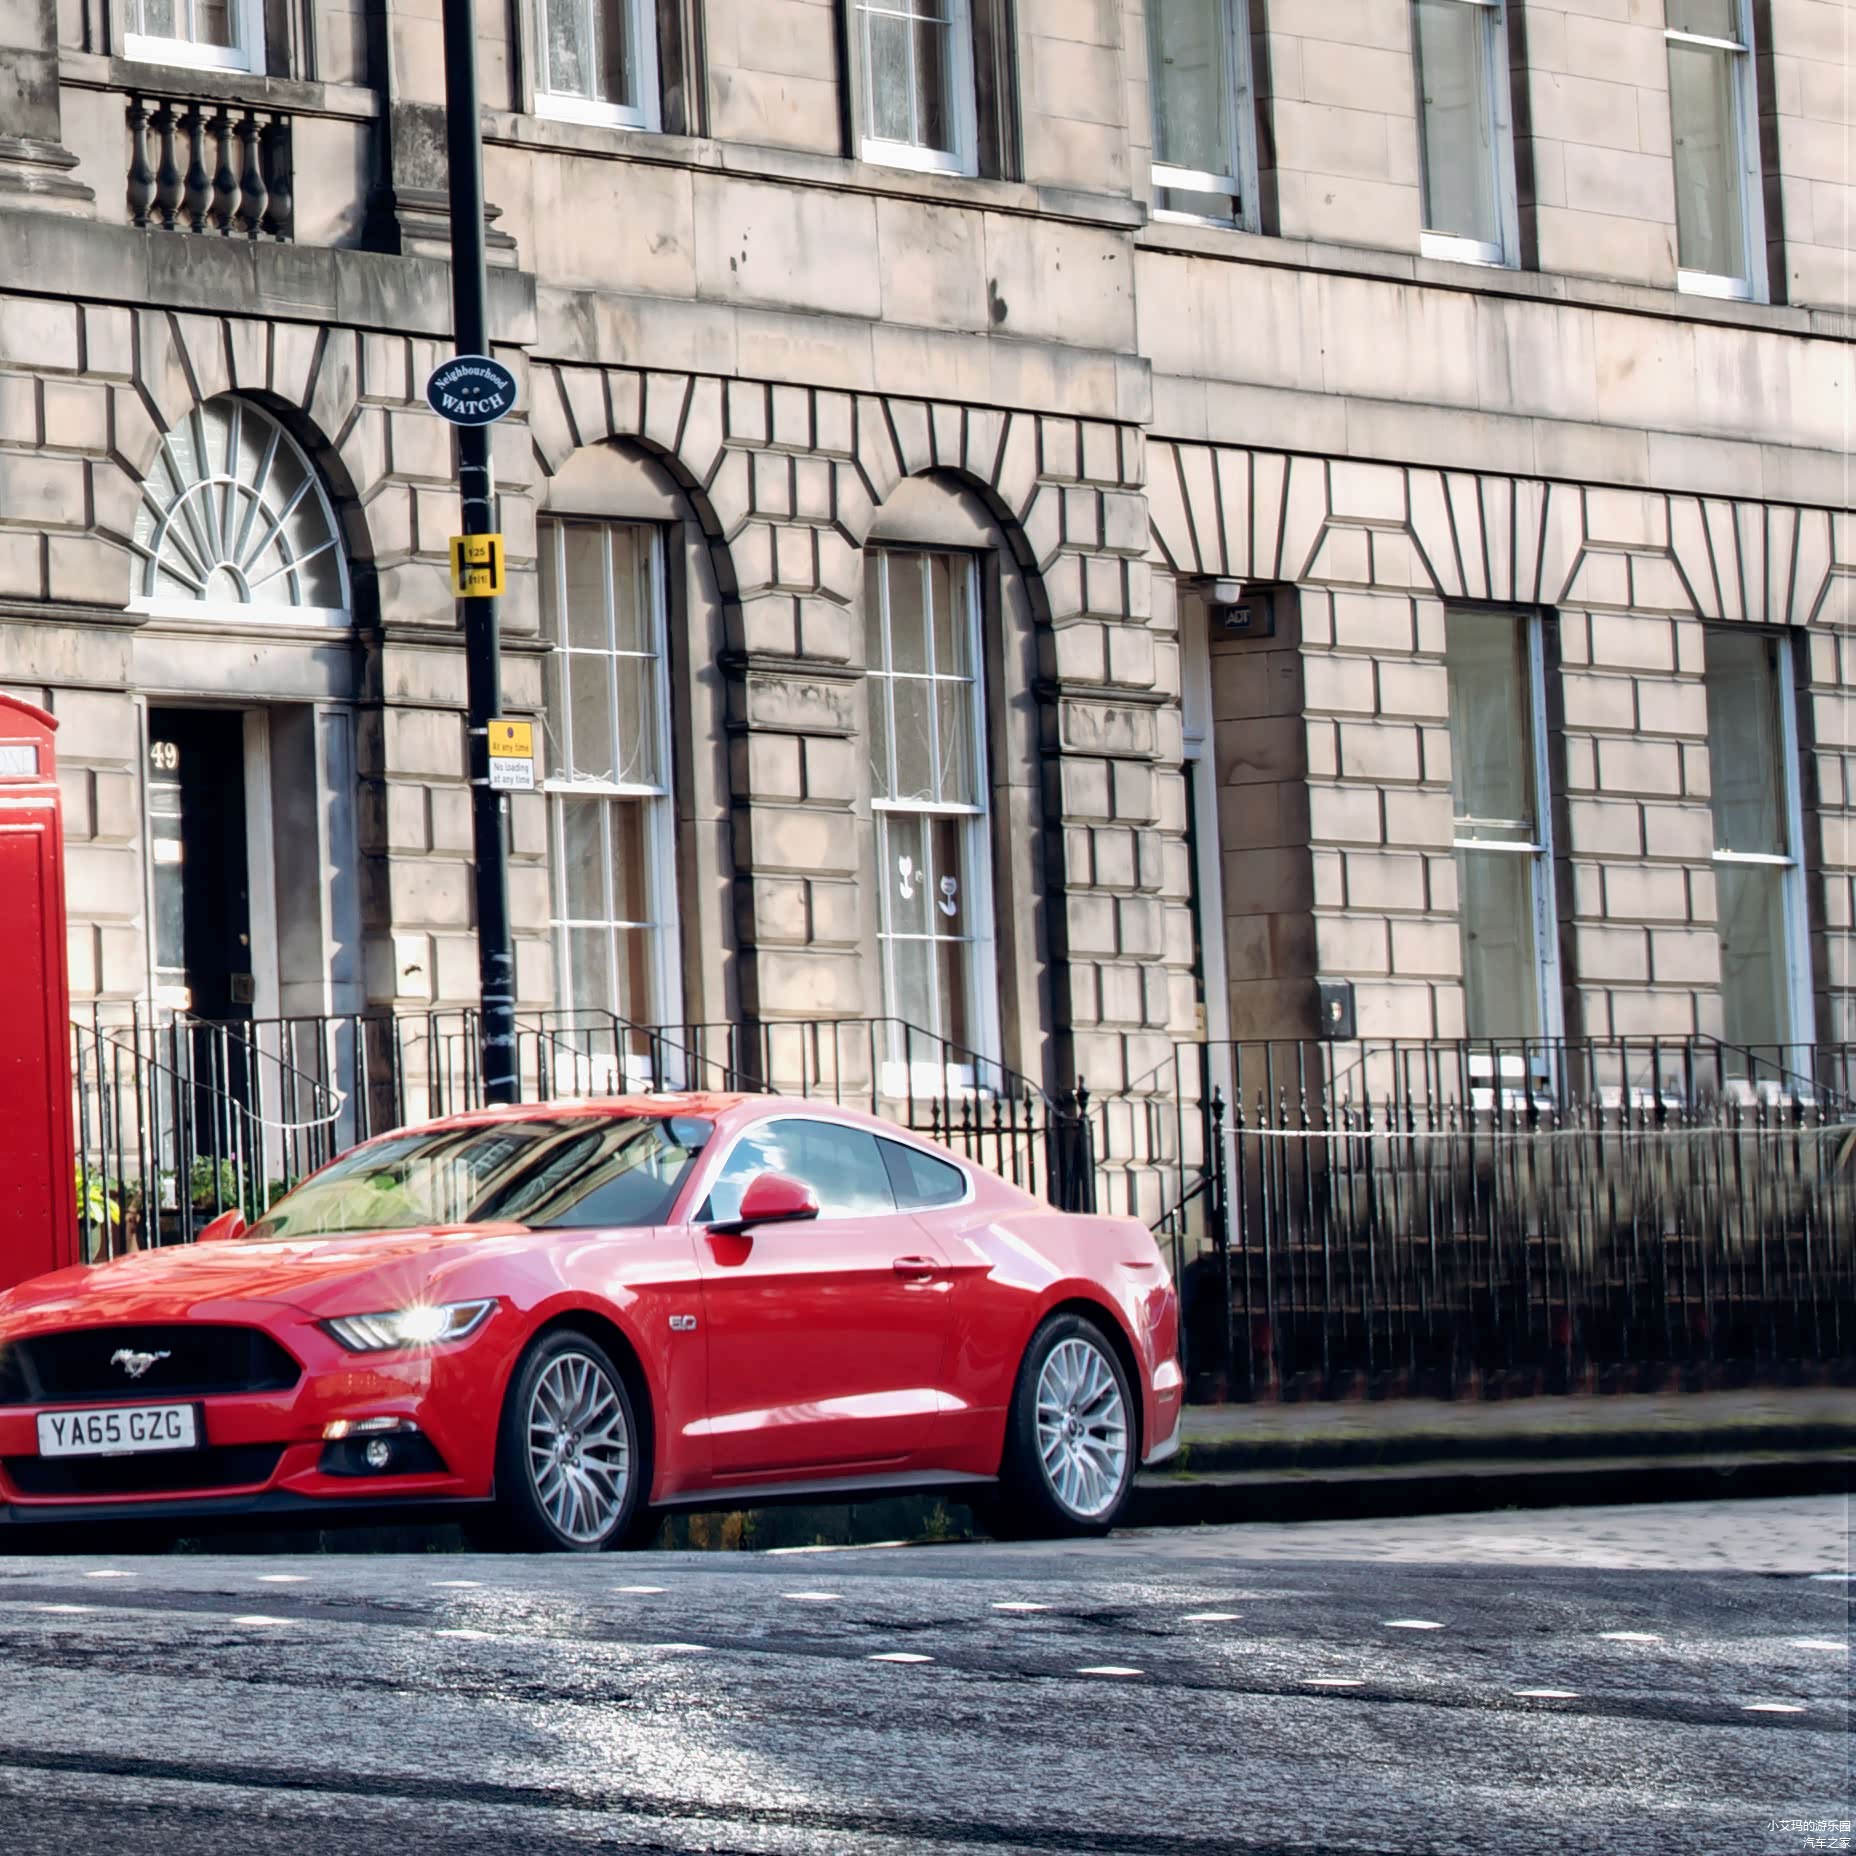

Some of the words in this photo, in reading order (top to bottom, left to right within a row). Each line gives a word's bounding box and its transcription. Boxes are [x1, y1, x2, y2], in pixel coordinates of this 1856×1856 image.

[434, 365, 508, 390] Neighbourhood
[441, 392, 505, 415] WATCH
[1225, 609, 1250, 624] ADT
[150, 741, 179, 769] 49
[51, 1413, 121, 1447] YA65
[129, 1410, 181, 1442] GZG
